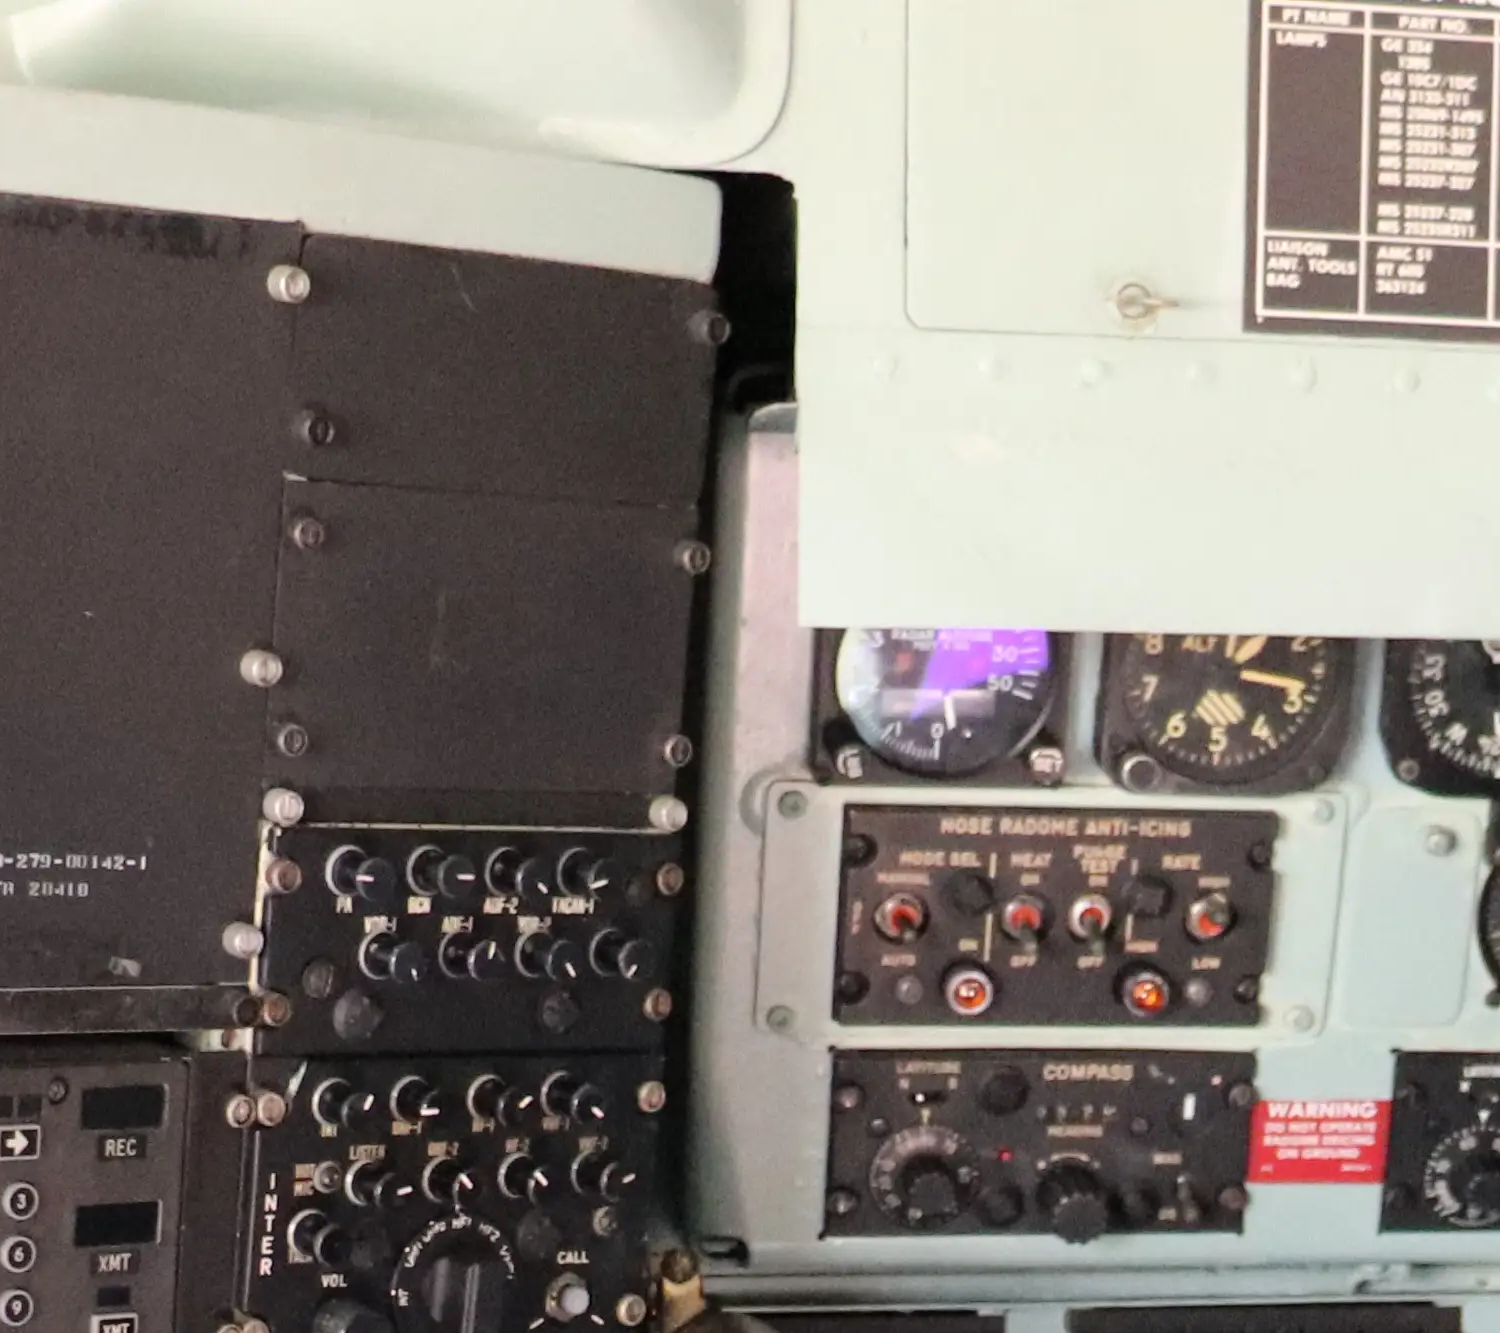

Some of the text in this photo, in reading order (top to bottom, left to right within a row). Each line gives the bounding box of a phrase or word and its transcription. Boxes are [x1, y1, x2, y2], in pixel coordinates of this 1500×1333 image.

[1206, 730, 1226, 752] 5
[940, 815, 1192, 839] NOSE RADOME ANTI-ICING
[1043, 1063, 1134, 1082] COMPASS
[1268, 1102, 1378, 1118] WARNING
[105, 1139, 137, 1157] REC
[259, 1173, 279, 1277] INTER
[98, 1253, 132, 1272] XMT
[556, 1250, 590, 1265] CALL
[321, 1274, 348, 1288] VOL
